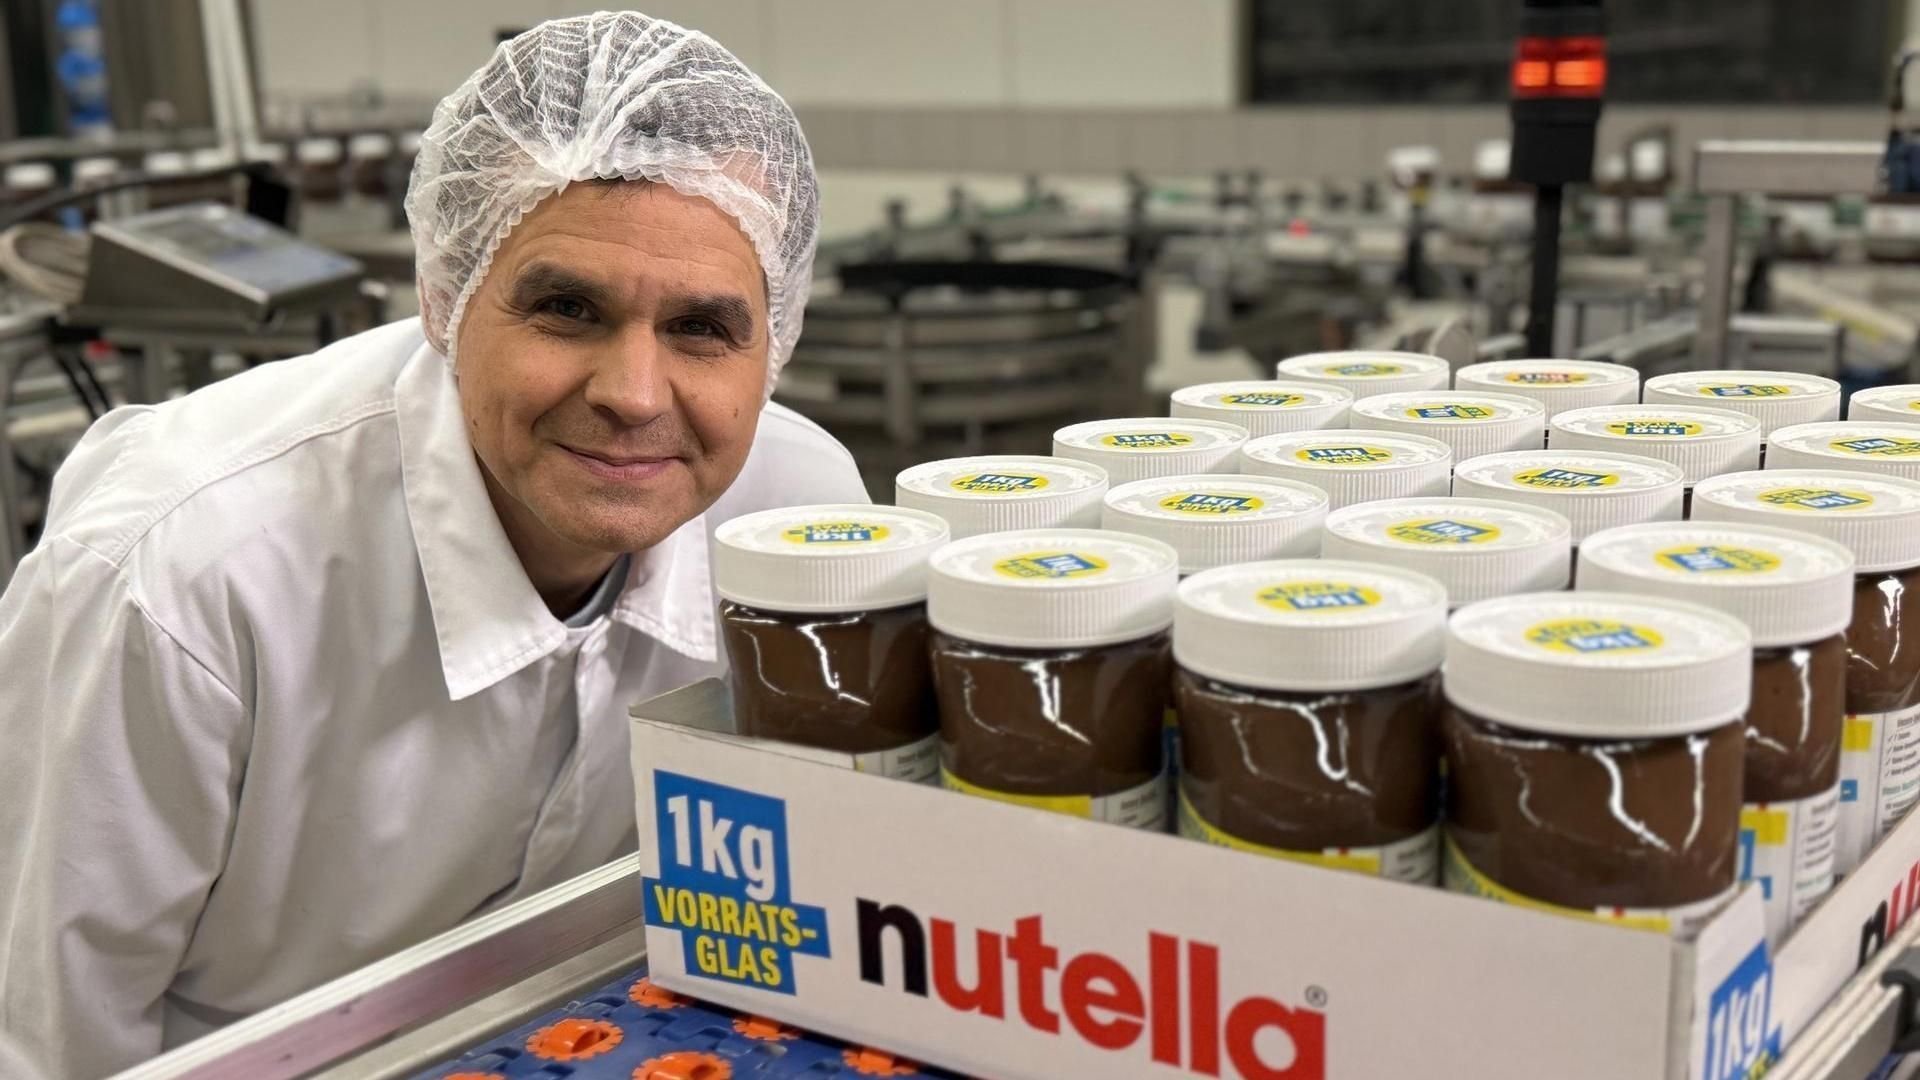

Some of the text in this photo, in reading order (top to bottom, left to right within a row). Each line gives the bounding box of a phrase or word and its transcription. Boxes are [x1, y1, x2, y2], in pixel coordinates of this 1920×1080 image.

[665, 794, 776, 901] 1kg
[653, 885, 818, 948] VORRATS-
[695, 933, 782, 987] GLAS
